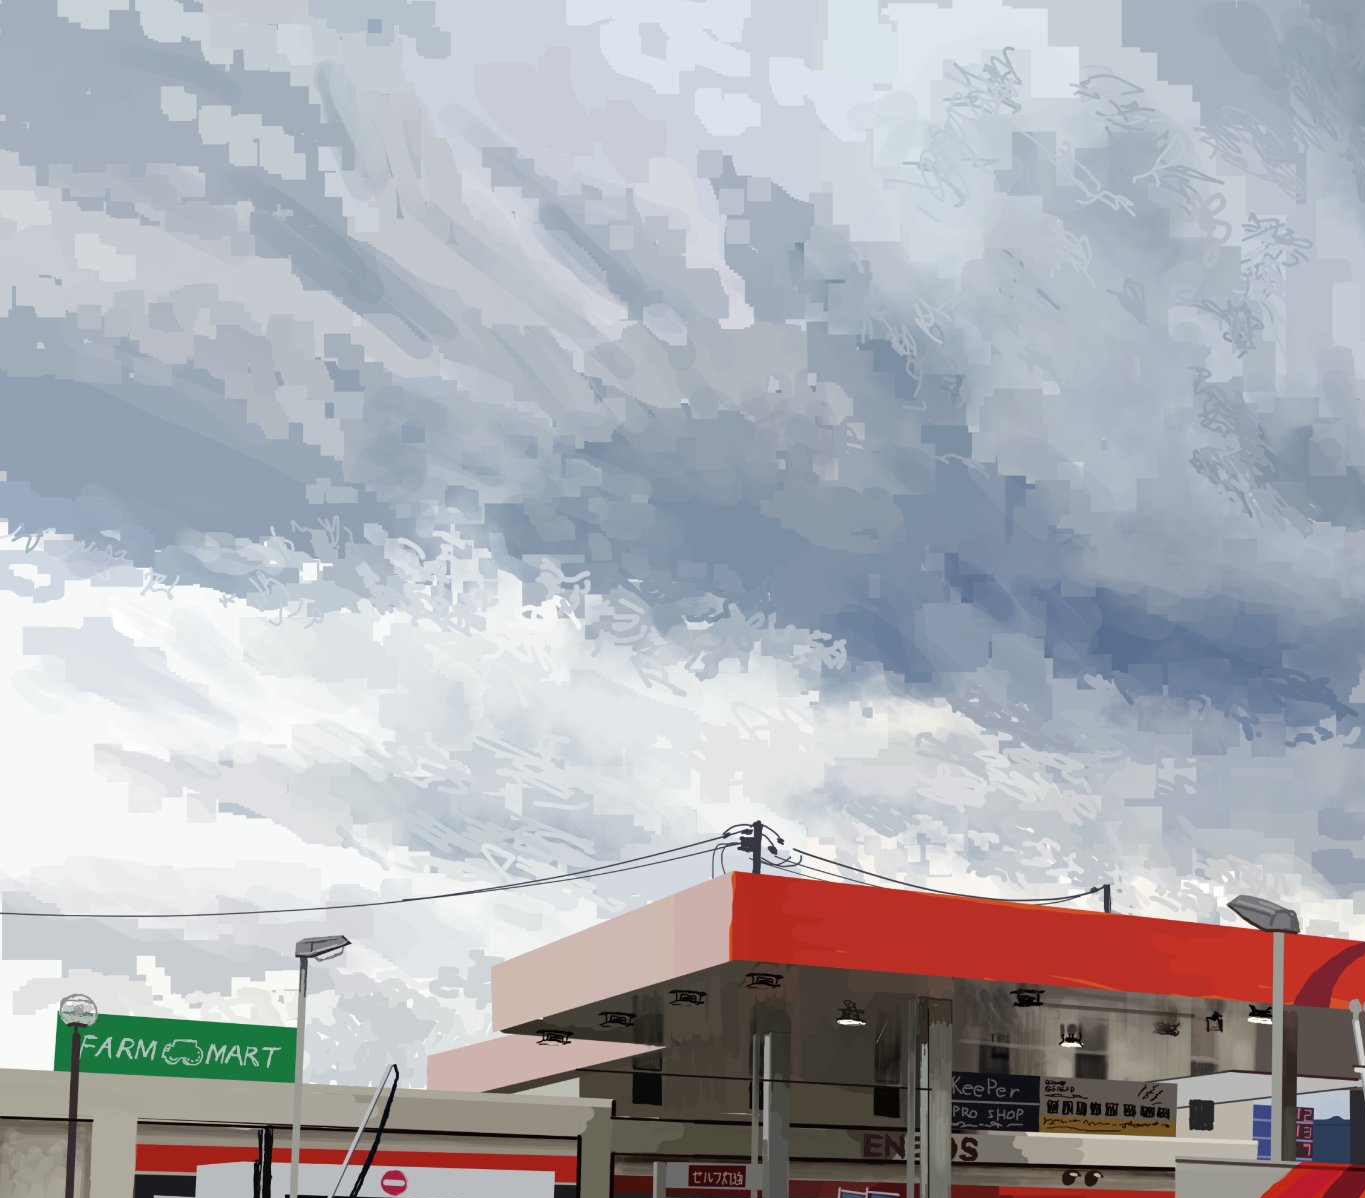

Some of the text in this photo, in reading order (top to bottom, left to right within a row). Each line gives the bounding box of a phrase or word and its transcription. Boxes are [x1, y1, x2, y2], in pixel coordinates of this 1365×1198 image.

[79, 1034, 282, 1069] FARM MART
[952, 1107, 978, 1119] PRO
[863, 1133, 979, 1162] ENS
